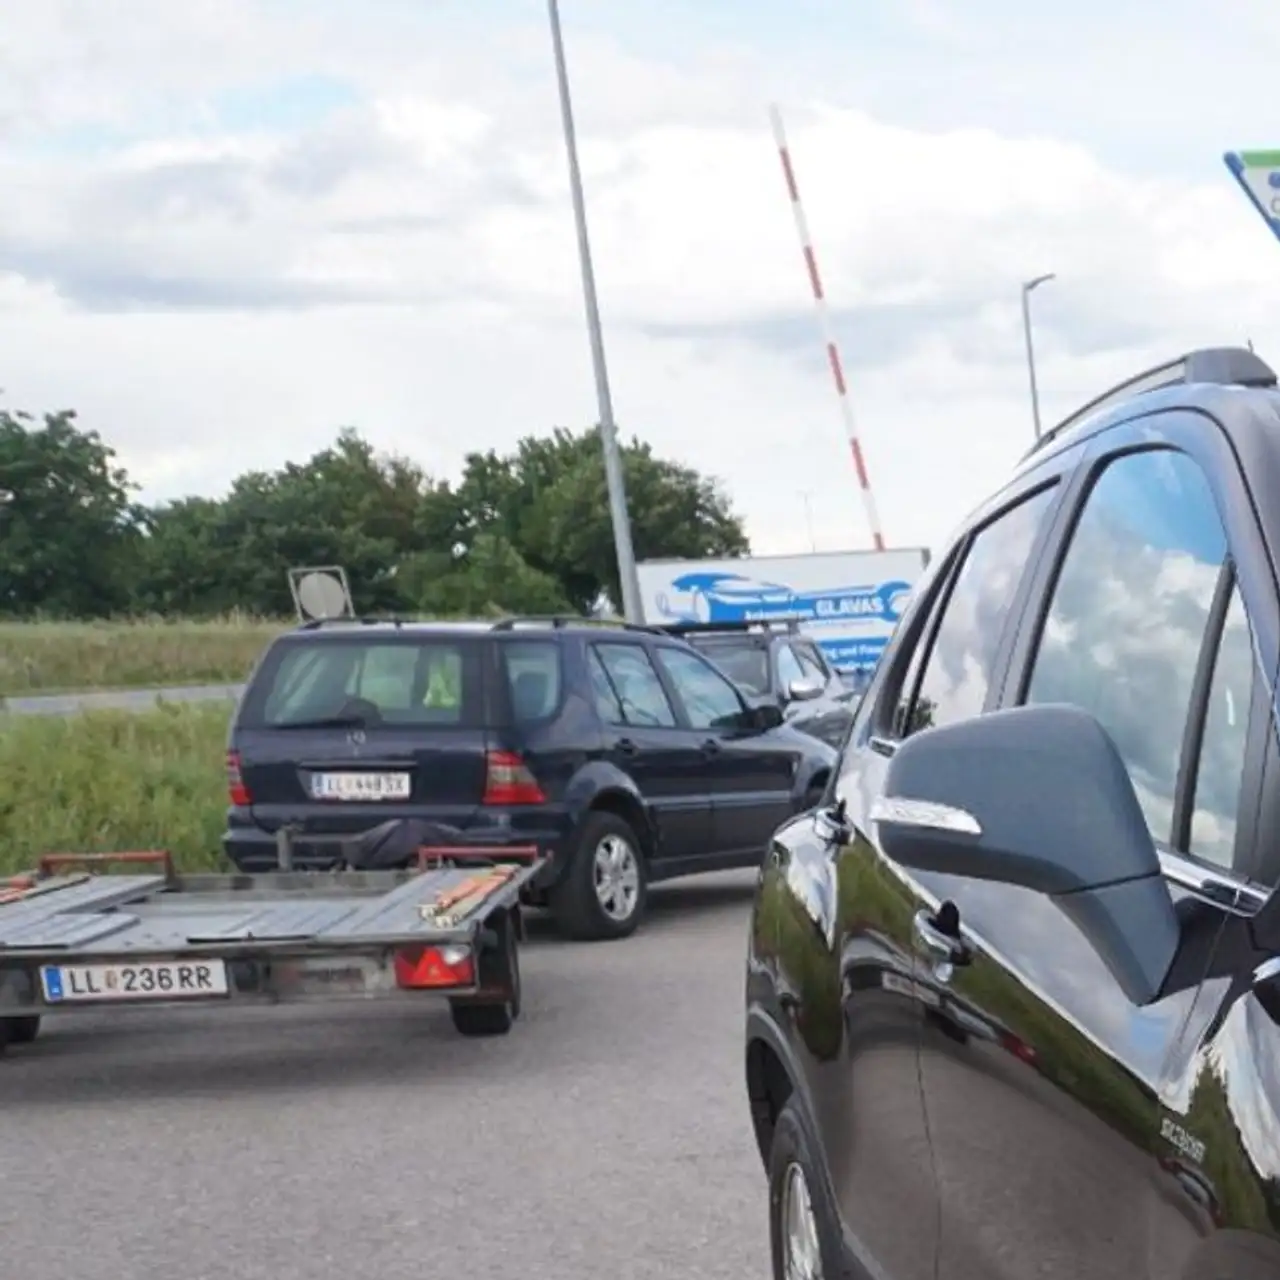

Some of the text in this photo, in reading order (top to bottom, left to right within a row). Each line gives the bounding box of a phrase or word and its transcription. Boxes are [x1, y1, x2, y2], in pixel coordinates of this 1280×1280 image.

[815, 596, 884, 617] GLAVAS
[68, 965, 213, 994] LL 236 RR
